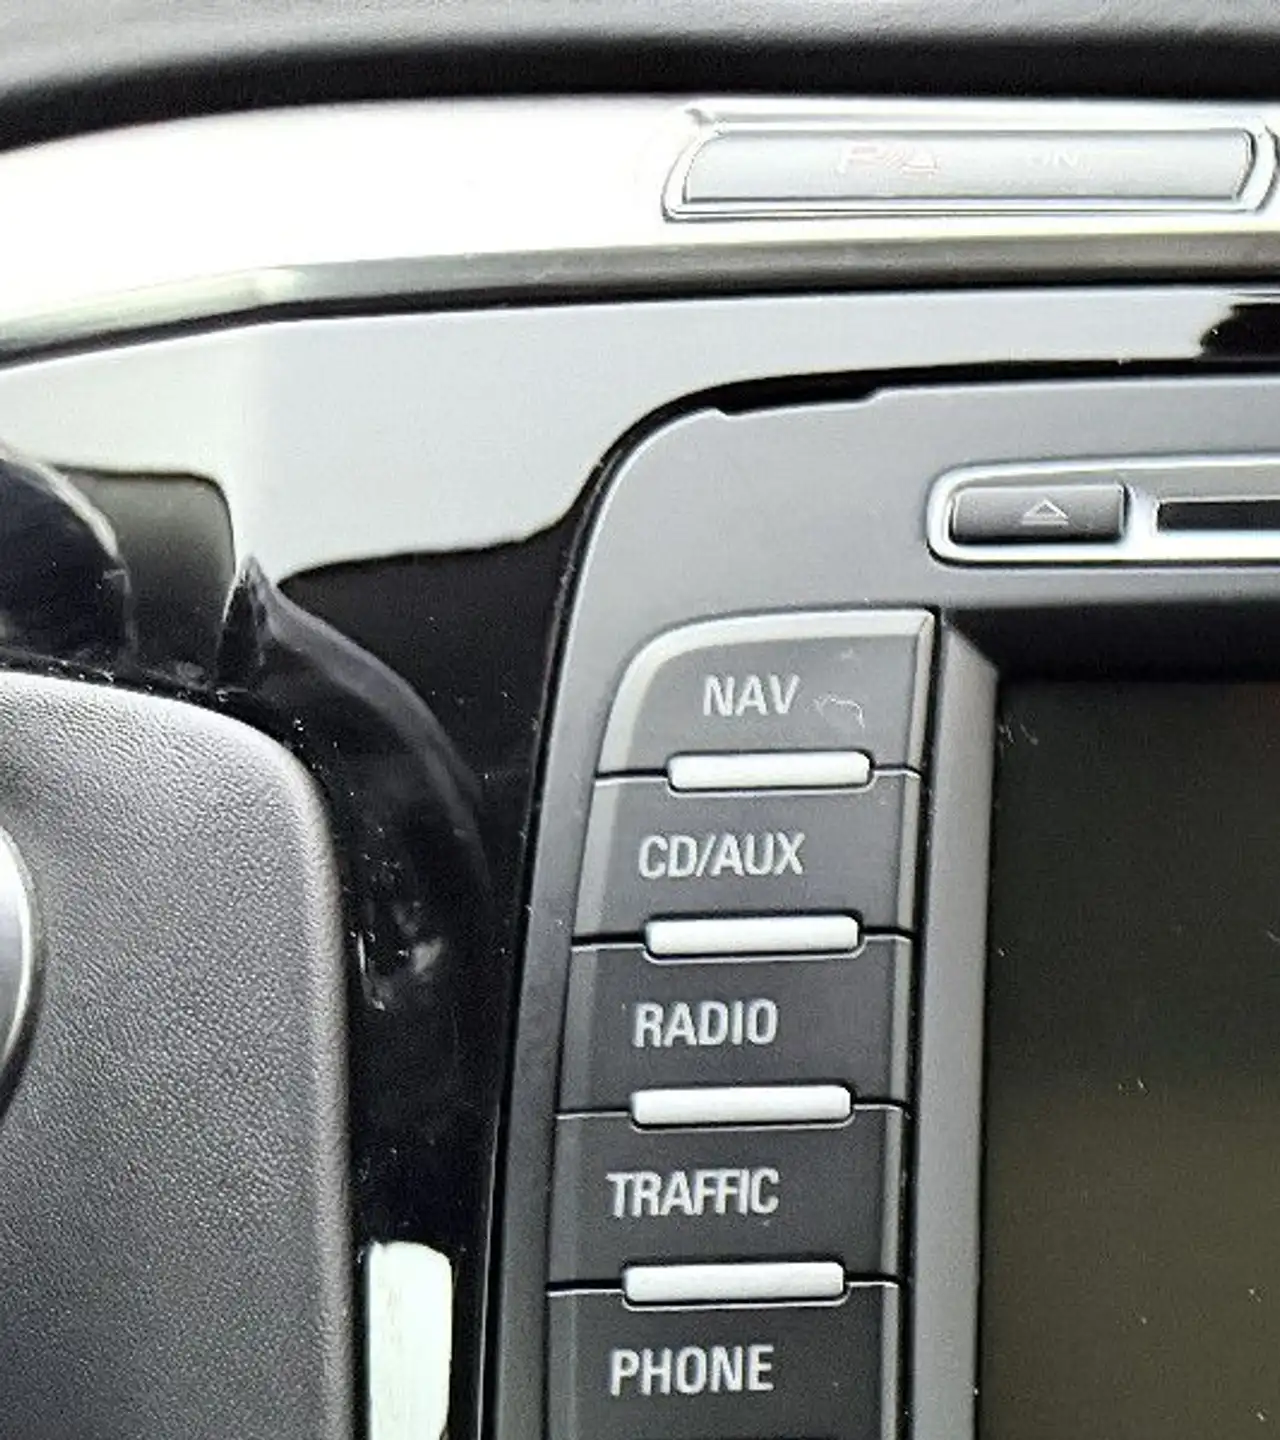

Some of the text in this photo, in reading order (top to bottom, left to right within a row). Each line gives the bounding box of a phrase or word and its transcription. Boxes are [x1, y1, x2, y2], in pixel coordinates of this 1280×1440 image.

[702, 673, 801, 718] NAV
[637, 831, 806, 880] CD/AUX
[633, 997, 779, 1049] RADIO
[604, 1167, 780, 1219] TRAFFIC
[609, 1344, 775, 1397] PHONE
